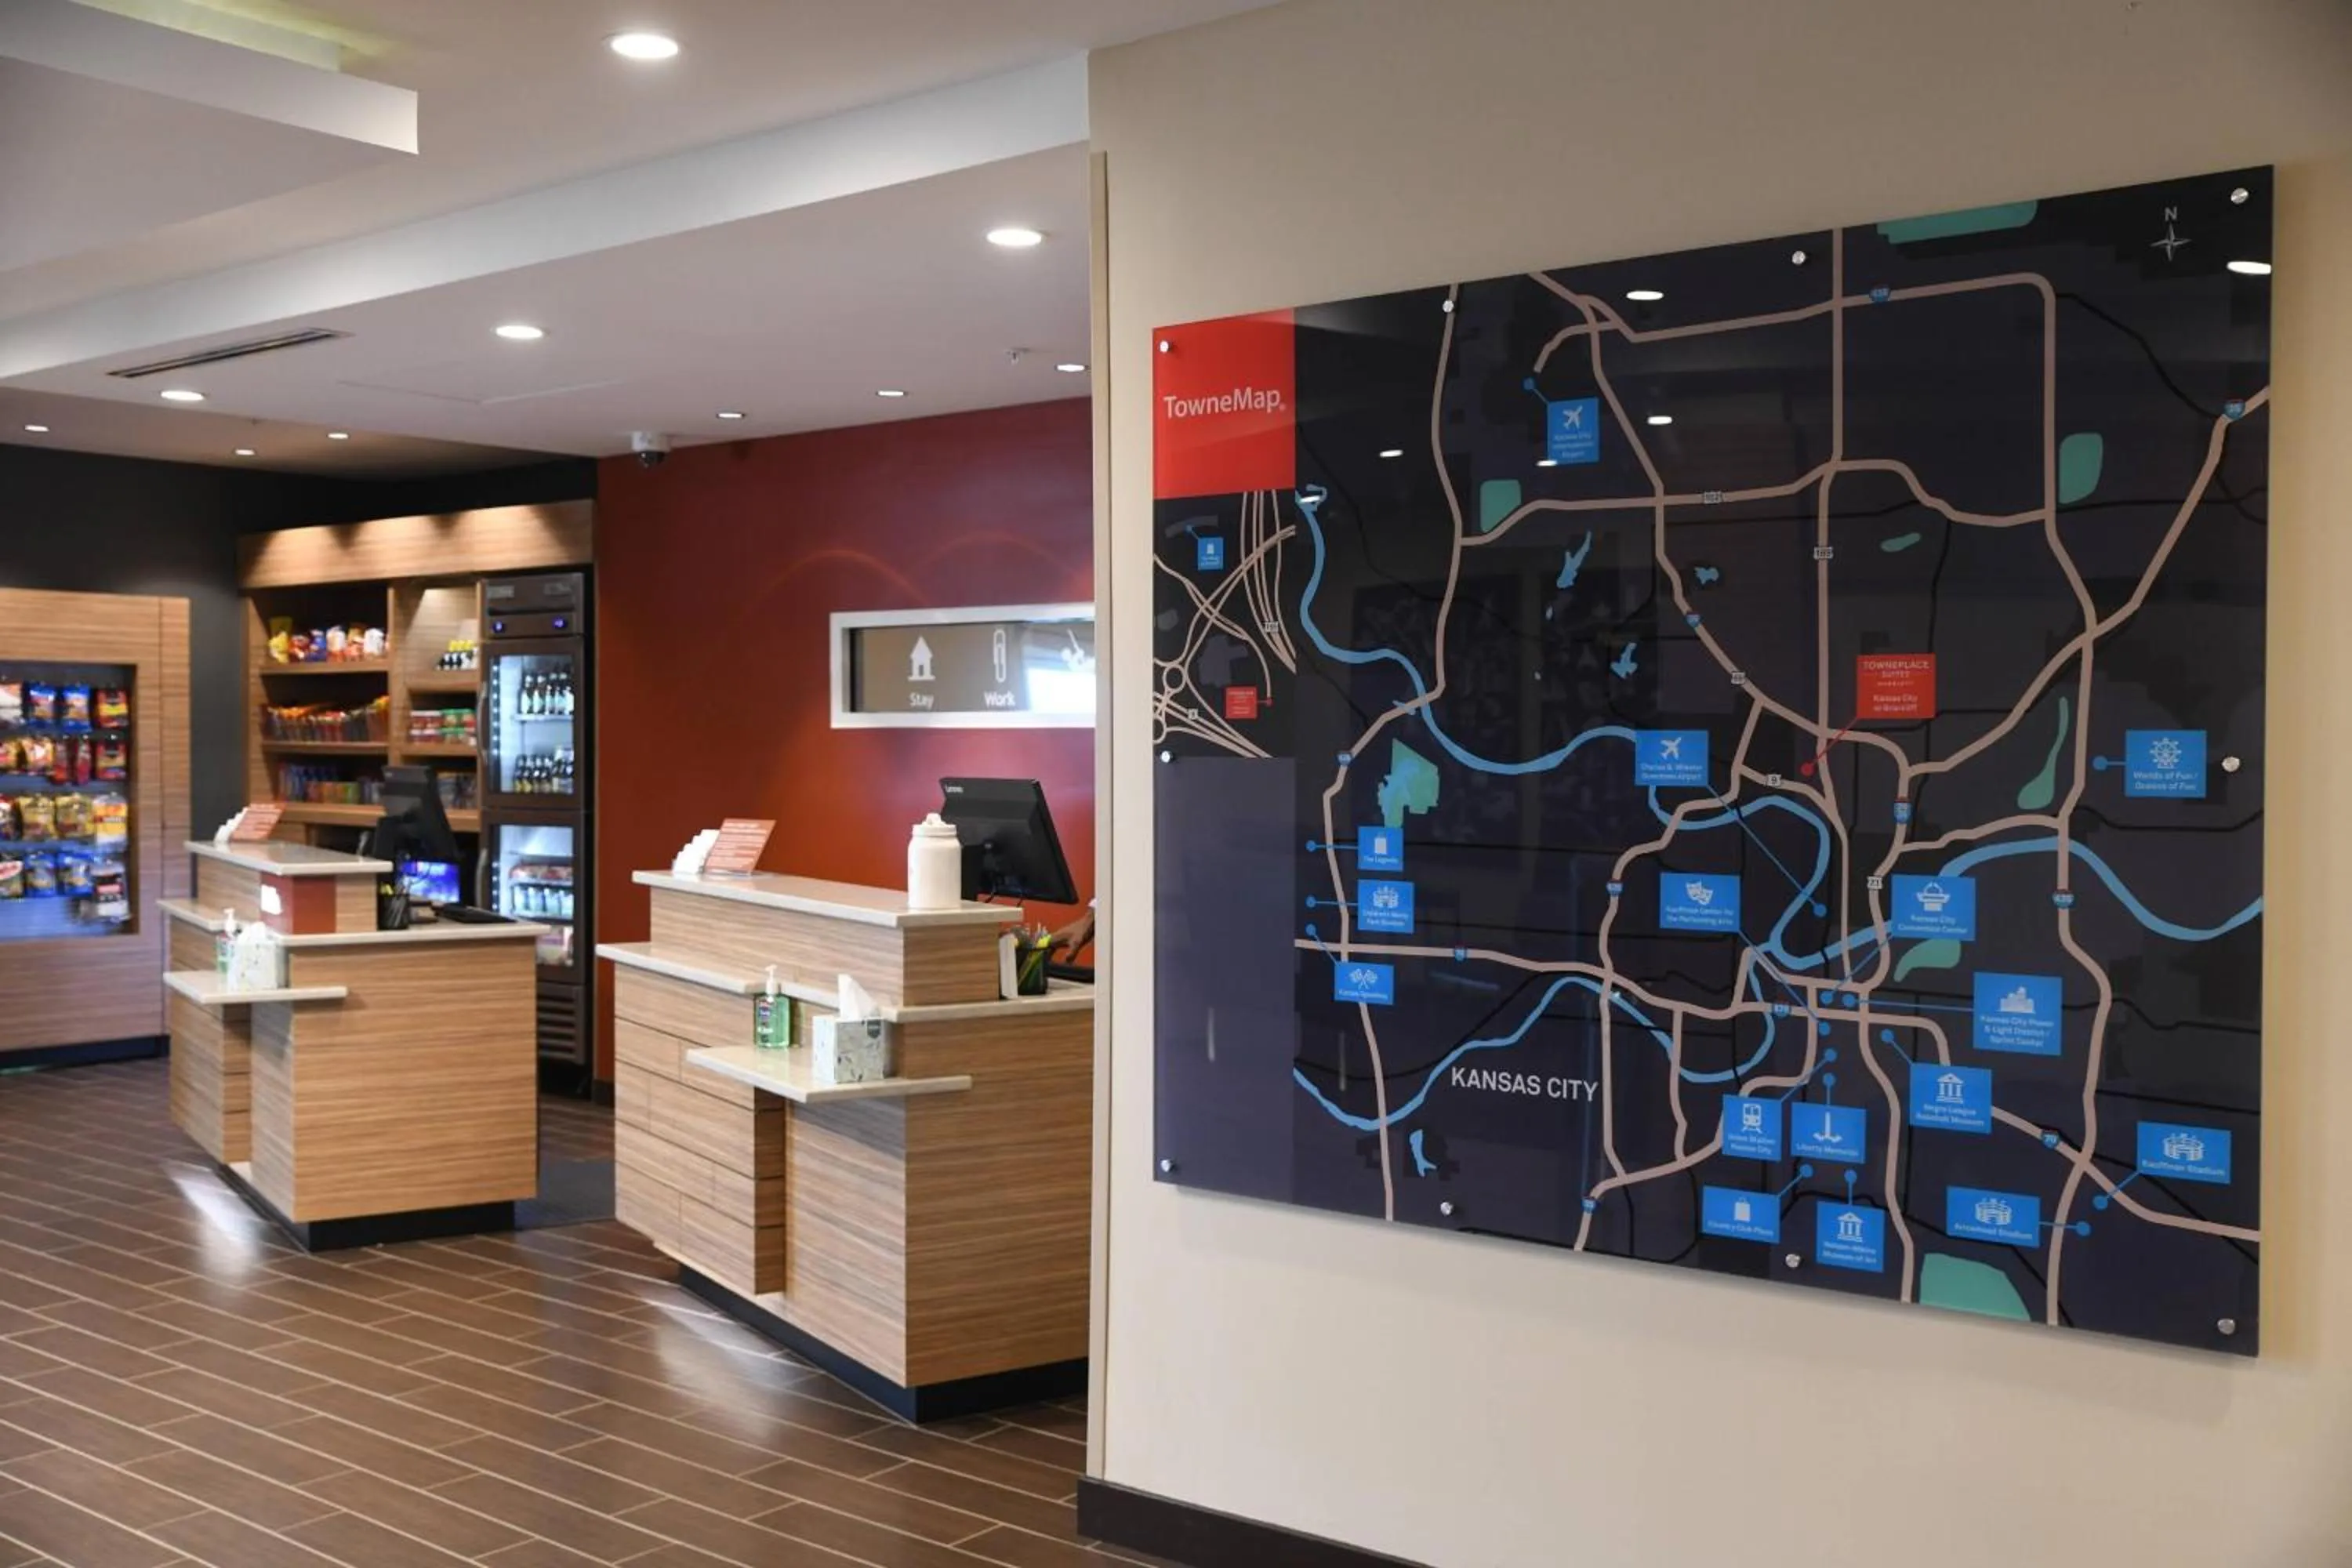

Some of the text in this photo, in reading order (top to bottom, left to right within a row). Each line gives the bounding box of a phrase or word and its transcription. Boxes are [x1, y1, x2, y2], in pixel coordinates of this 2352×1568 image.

[2165, 206, 2177, 220] N
[909, 691, 935, 710] Stay
[984, 690, 1017, 707] Work
[1451, 1065, 1599, 1102] KANSAS CITY
